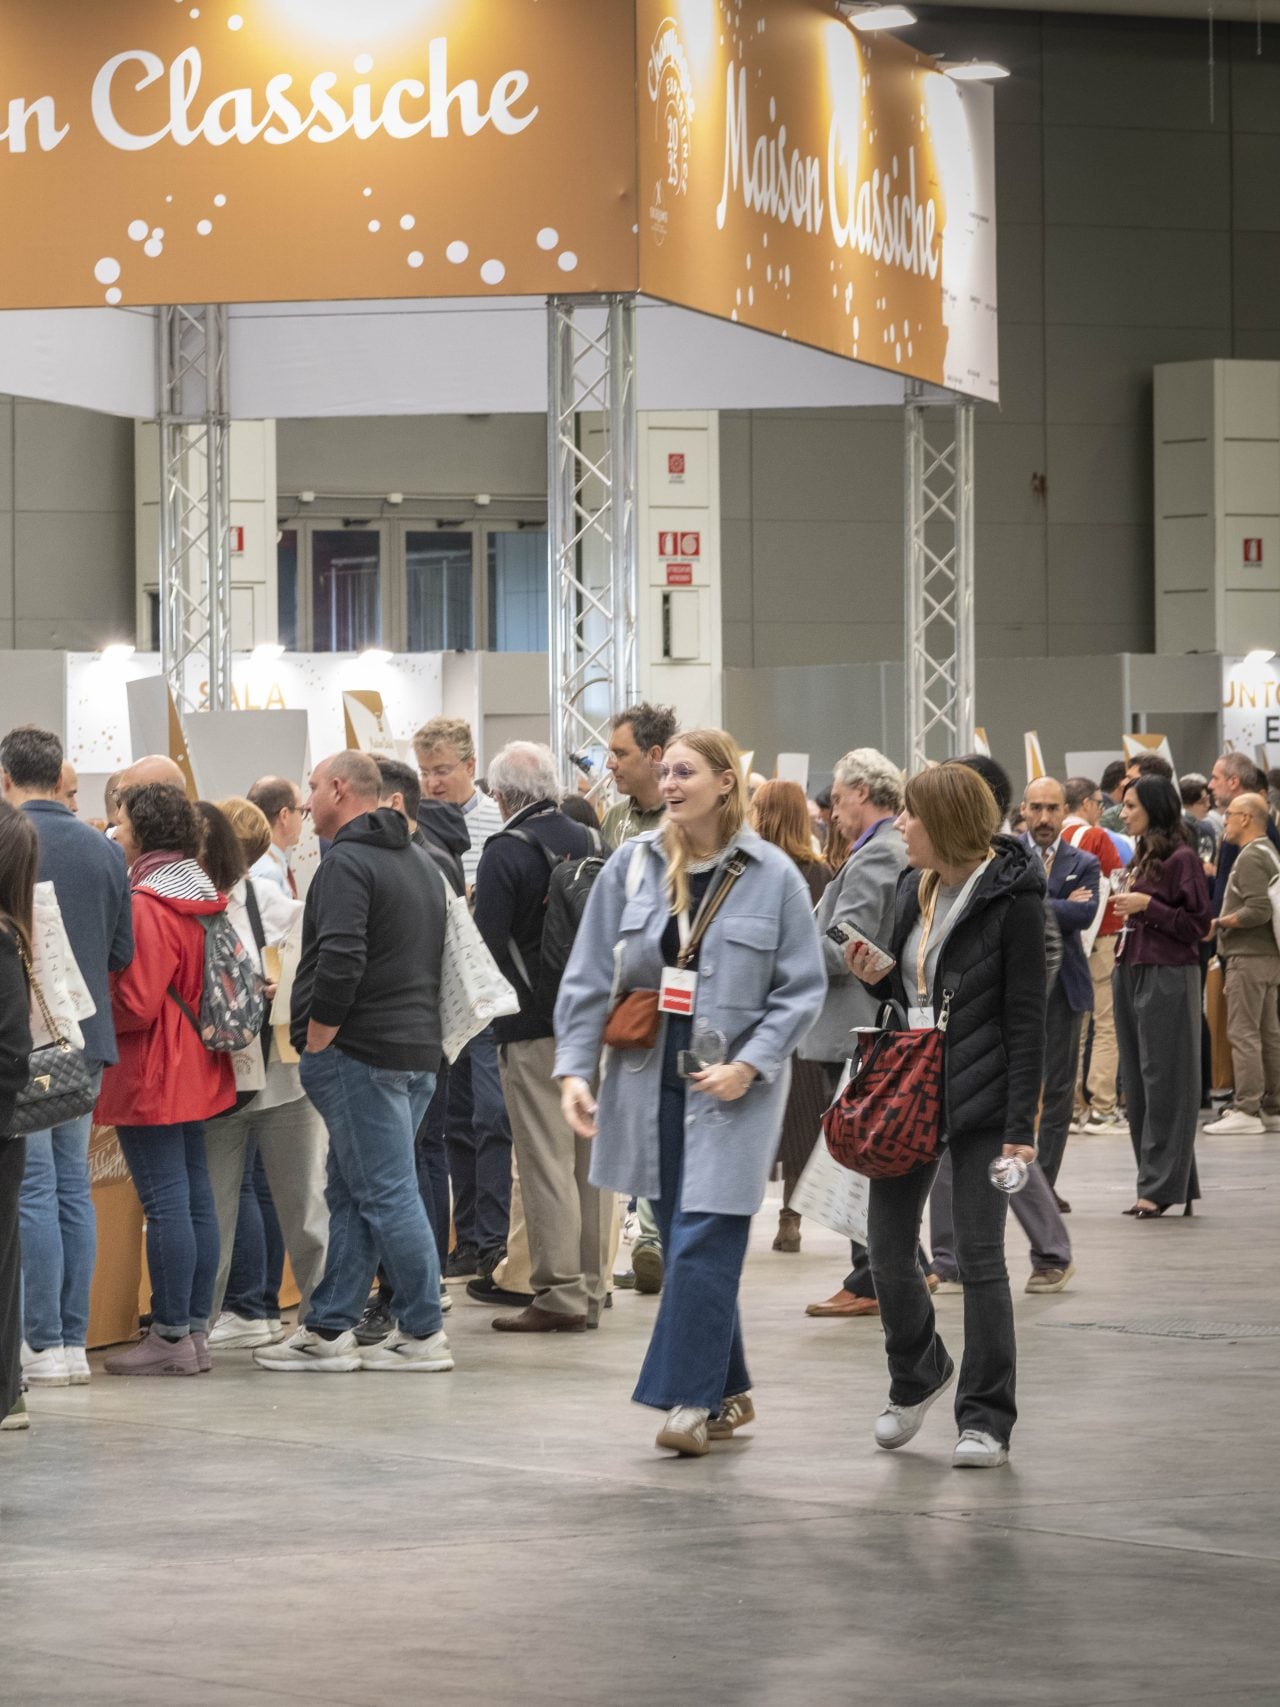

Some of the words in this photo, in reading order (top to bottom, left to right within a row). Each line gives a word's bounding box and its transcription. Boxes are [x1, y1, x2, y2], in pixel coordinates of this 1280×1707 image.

[91, 37, 539, 151] Classiche
[716, 60, 823, 235] Maison
[1264, 681, 1280, 708] T
